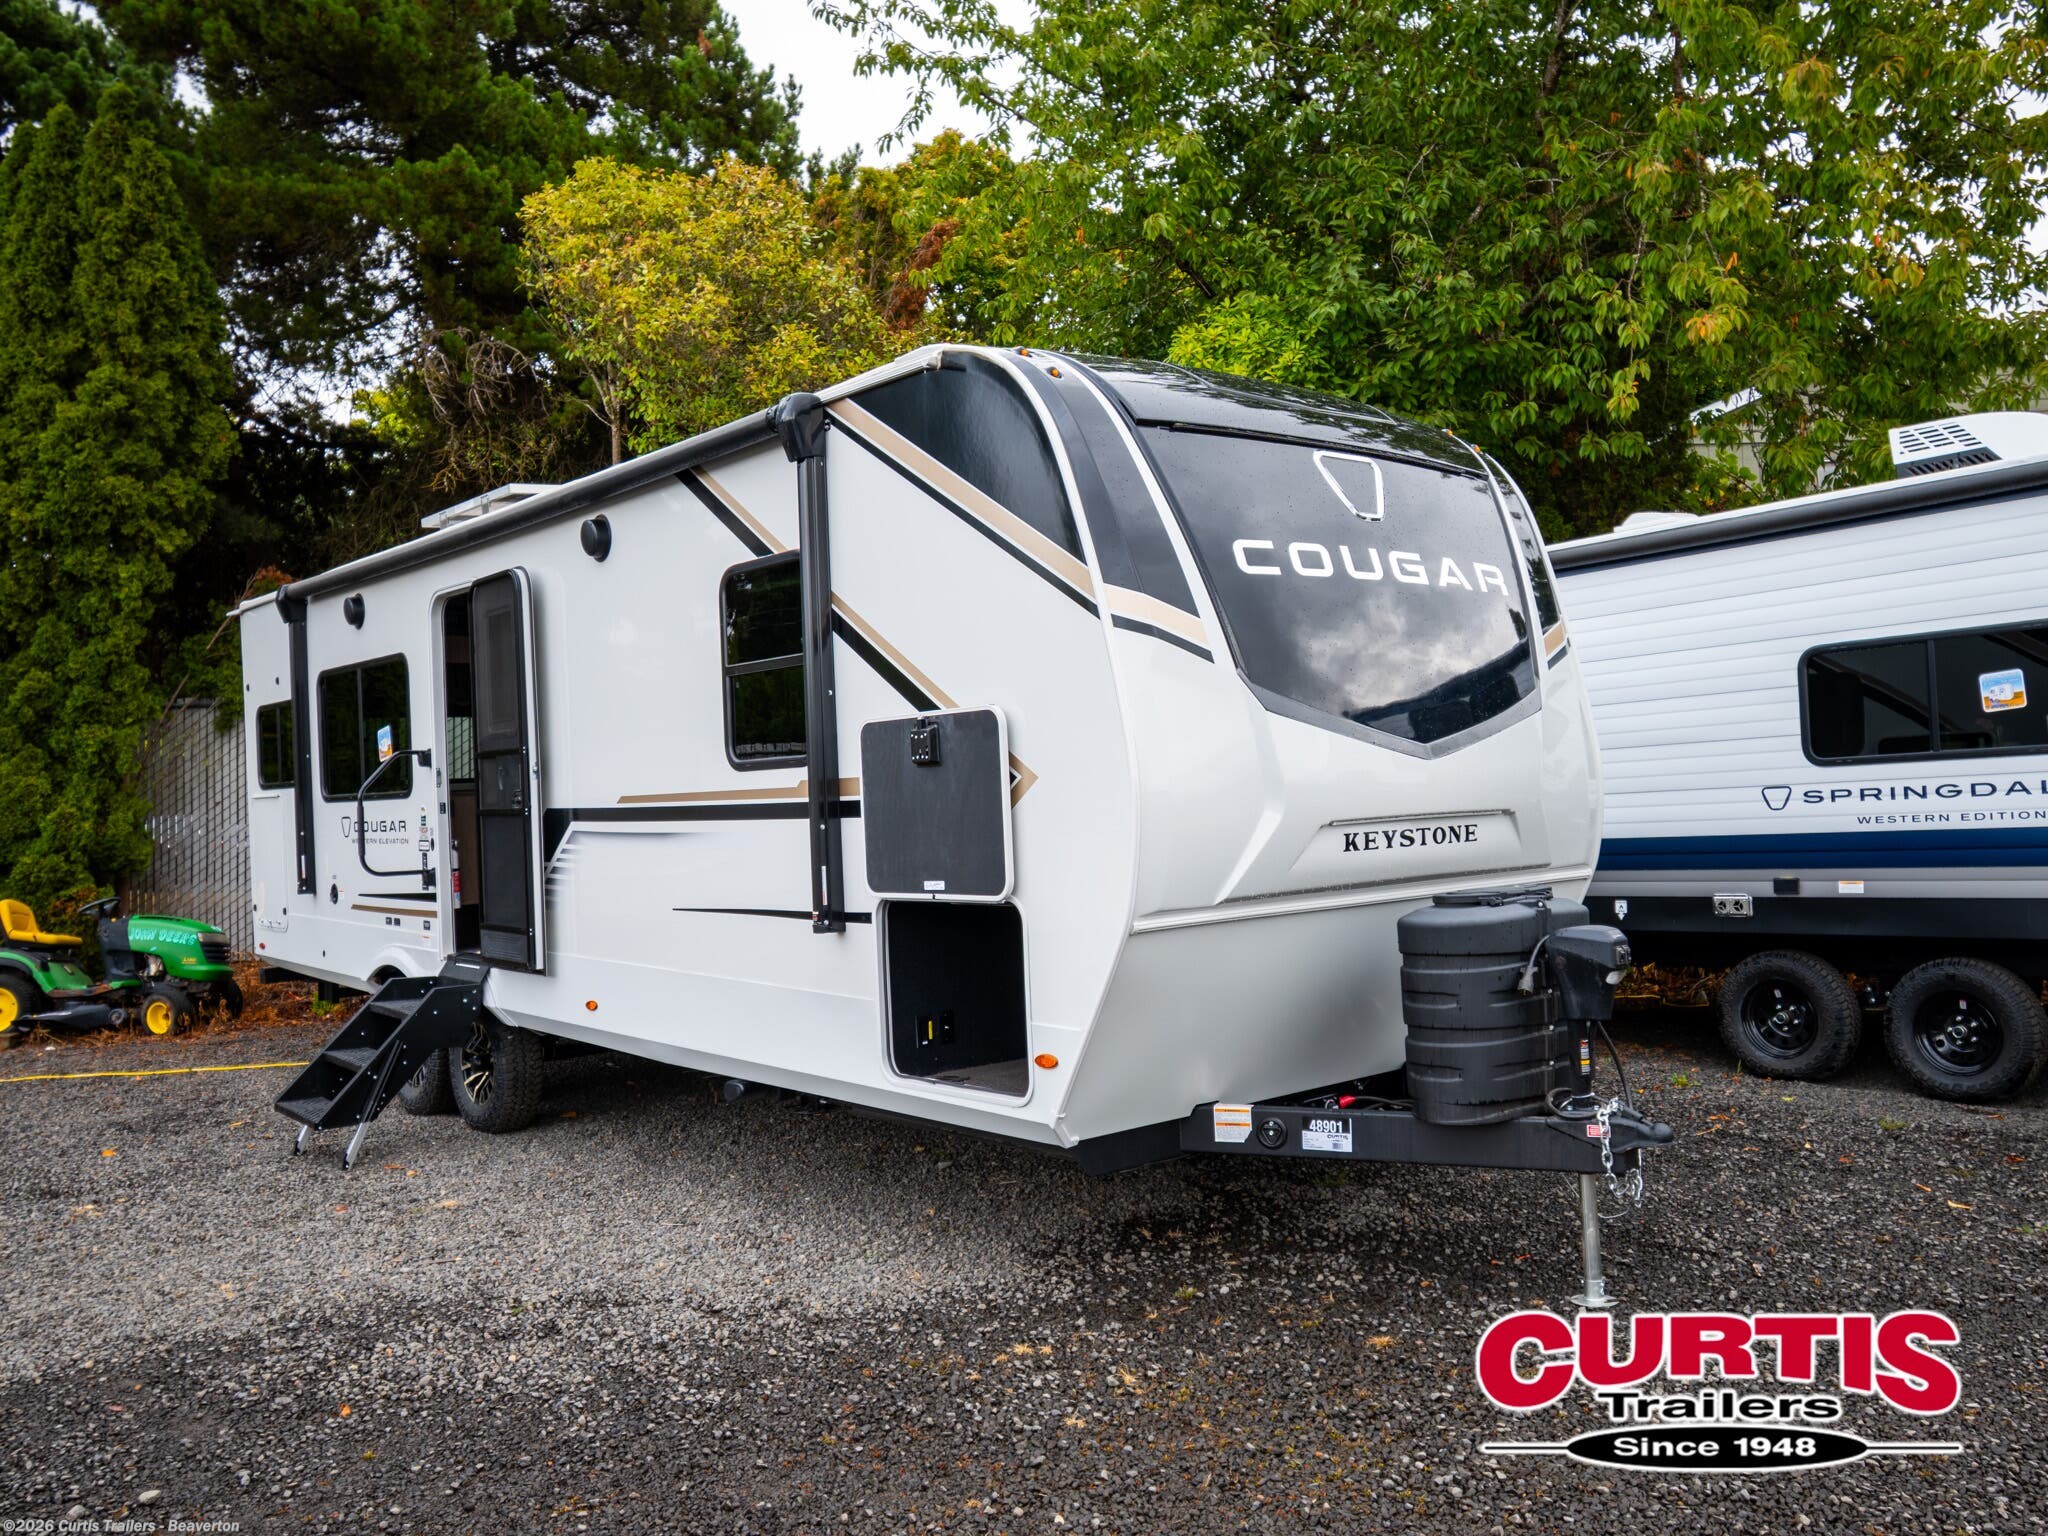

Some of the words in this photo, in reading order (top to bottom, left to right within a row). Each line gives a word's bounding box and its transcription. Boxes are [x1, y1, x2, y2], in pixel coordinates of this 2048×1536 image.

[1232, 538, 1510, 597] COUGAR
[1857, 812, 1950, 825] WESTERN
[1960, 810, 2047, 823] EDITION
[1343, 824, 1478, 853] KEYSTONE
[1309, 1119, 1343, 1134] 48901
